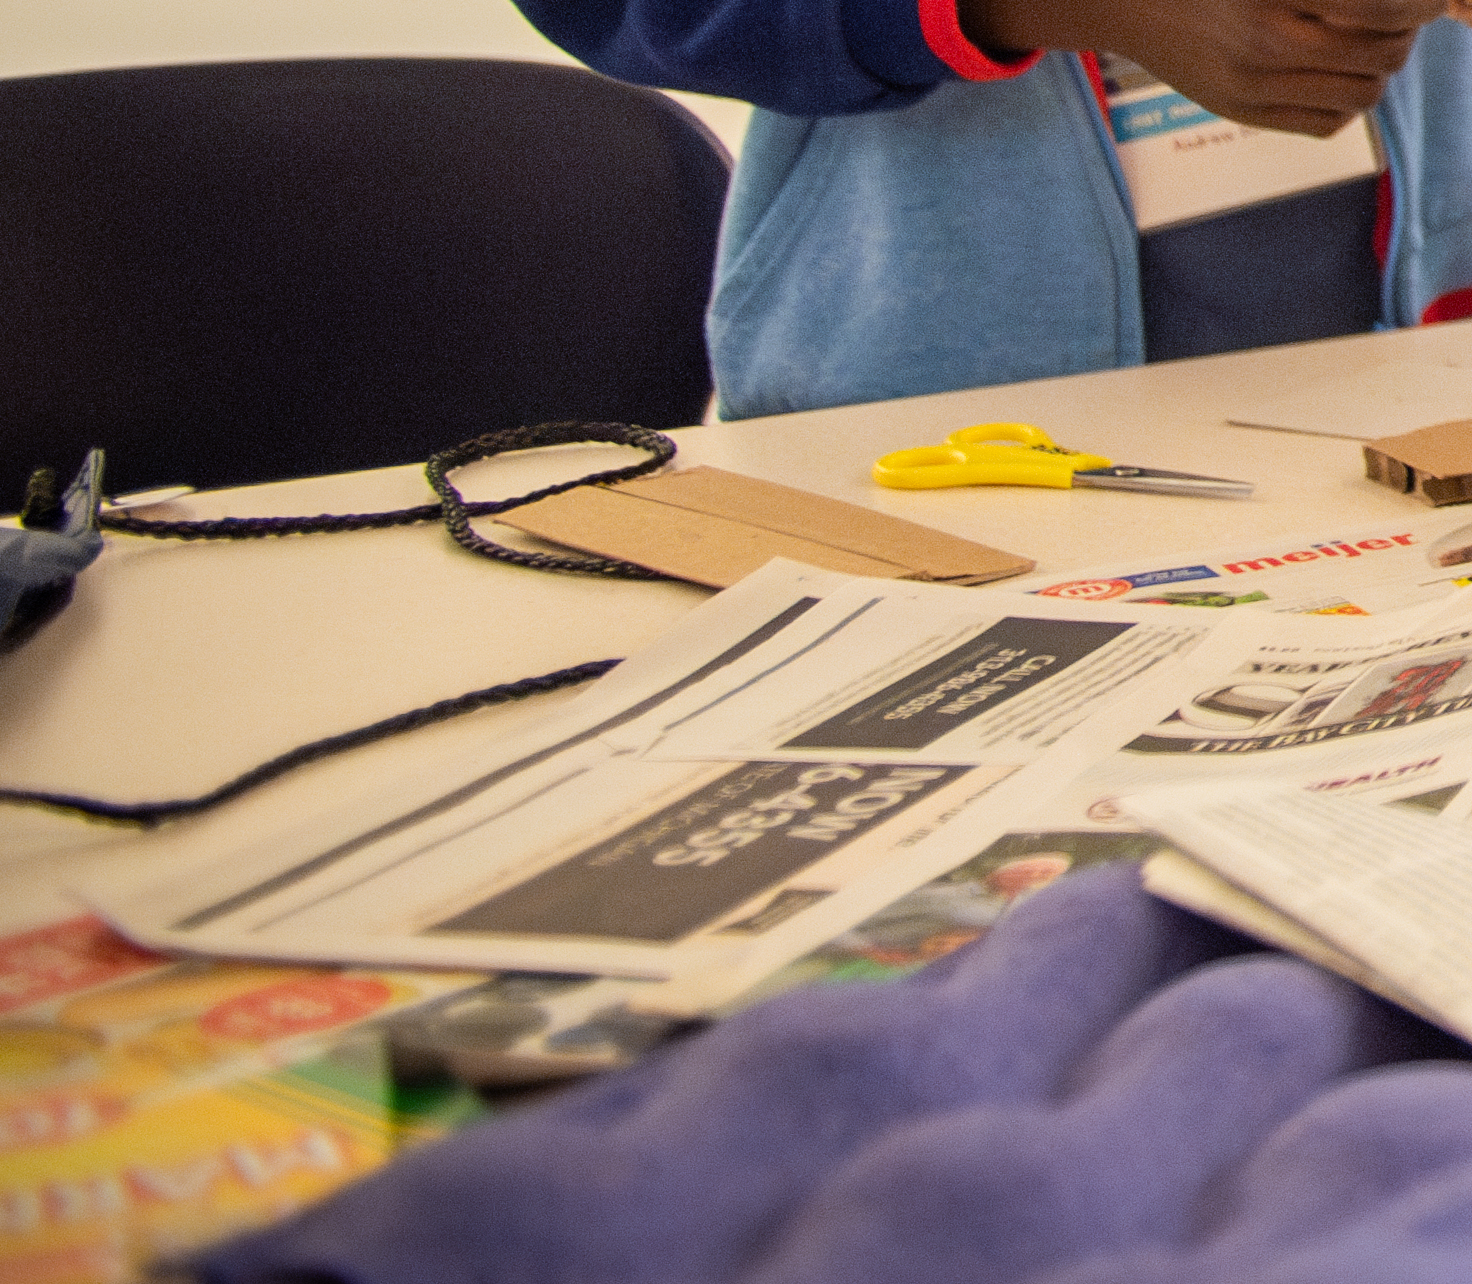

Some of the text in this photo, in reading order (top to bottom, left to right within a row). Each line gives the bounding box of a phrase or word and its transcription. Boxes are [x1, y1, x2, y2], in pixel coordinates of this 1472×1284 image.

[1223, 531, 1417, 575] meijer
[934, 651, 1060, 715] CALL NOW
[1189, 737, 1261, 753] THE
[1266, 729, 1331, 749] BAY
[1336, 708, 1423, 736] CITY
[787, 767, 947, 841] NOW
